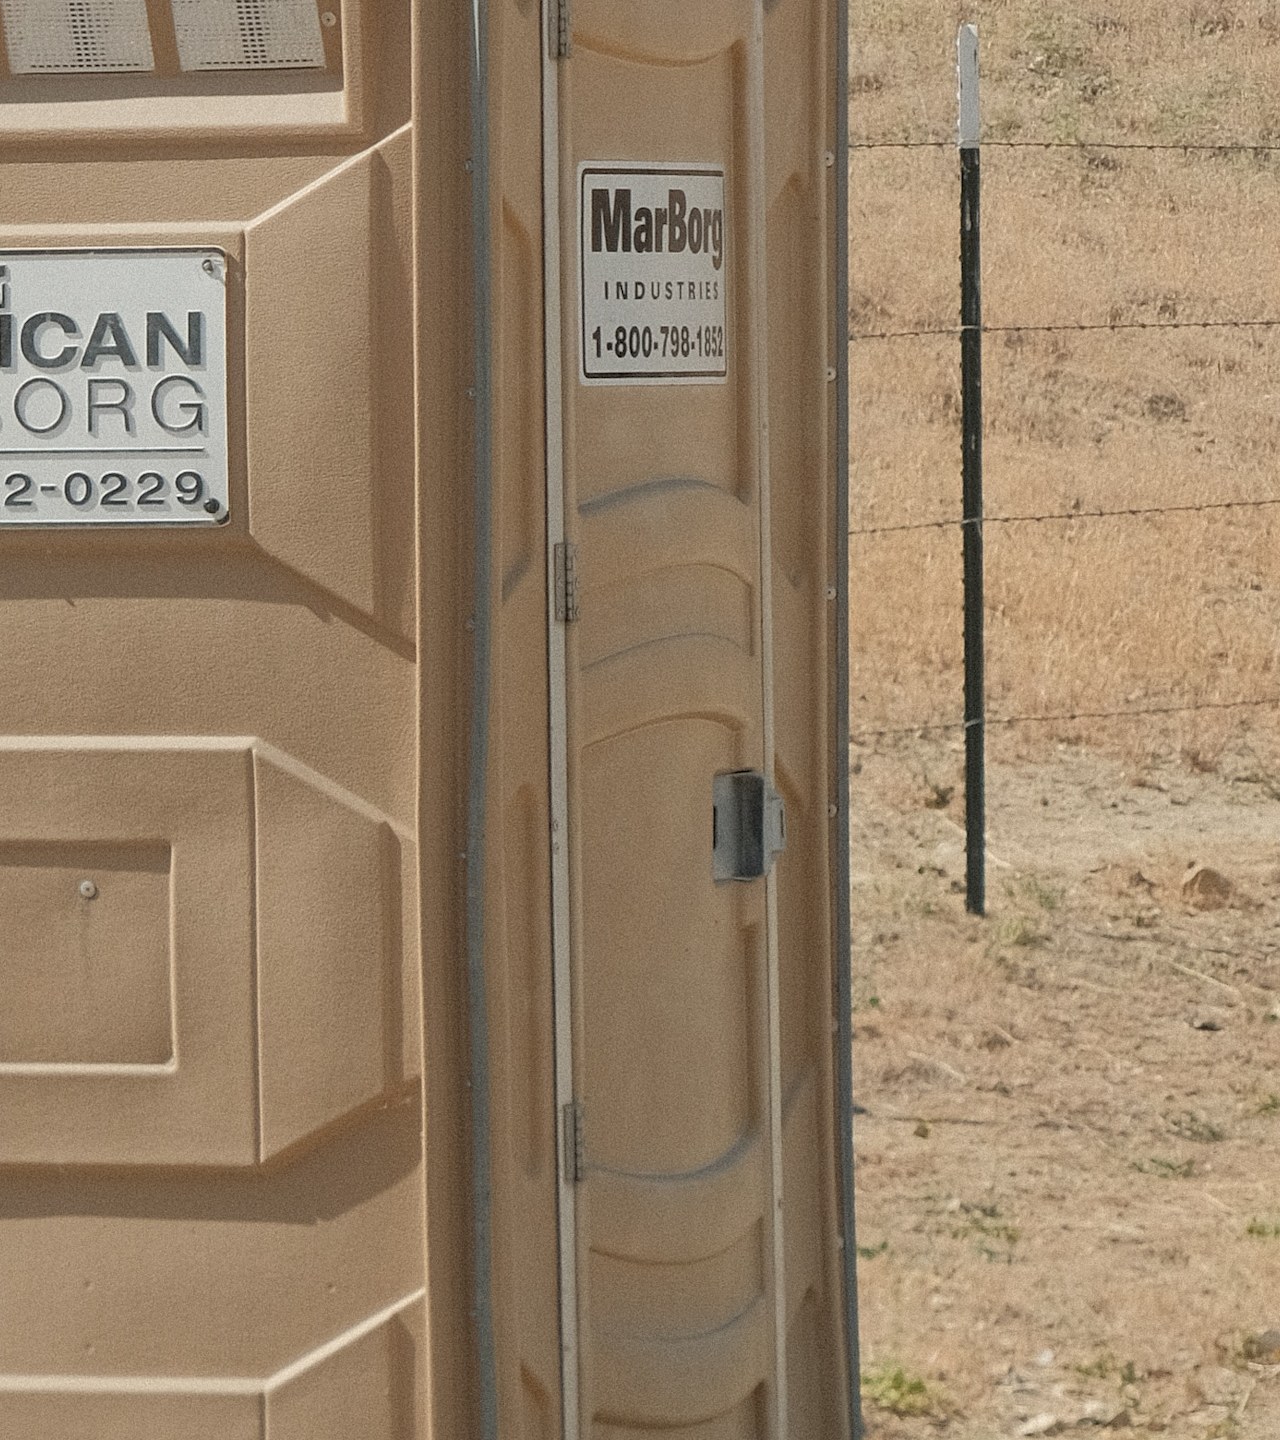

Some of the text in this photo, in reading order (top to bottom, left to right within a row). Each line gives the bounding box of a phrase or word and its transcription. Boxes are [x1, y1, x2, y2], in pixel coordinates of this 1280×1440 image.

[591, 188, 723, 271] MarBorg
[604, 281, 719, 300] INDUSTRIES
[591, 325, 724, 358] 1-800-798-1852
